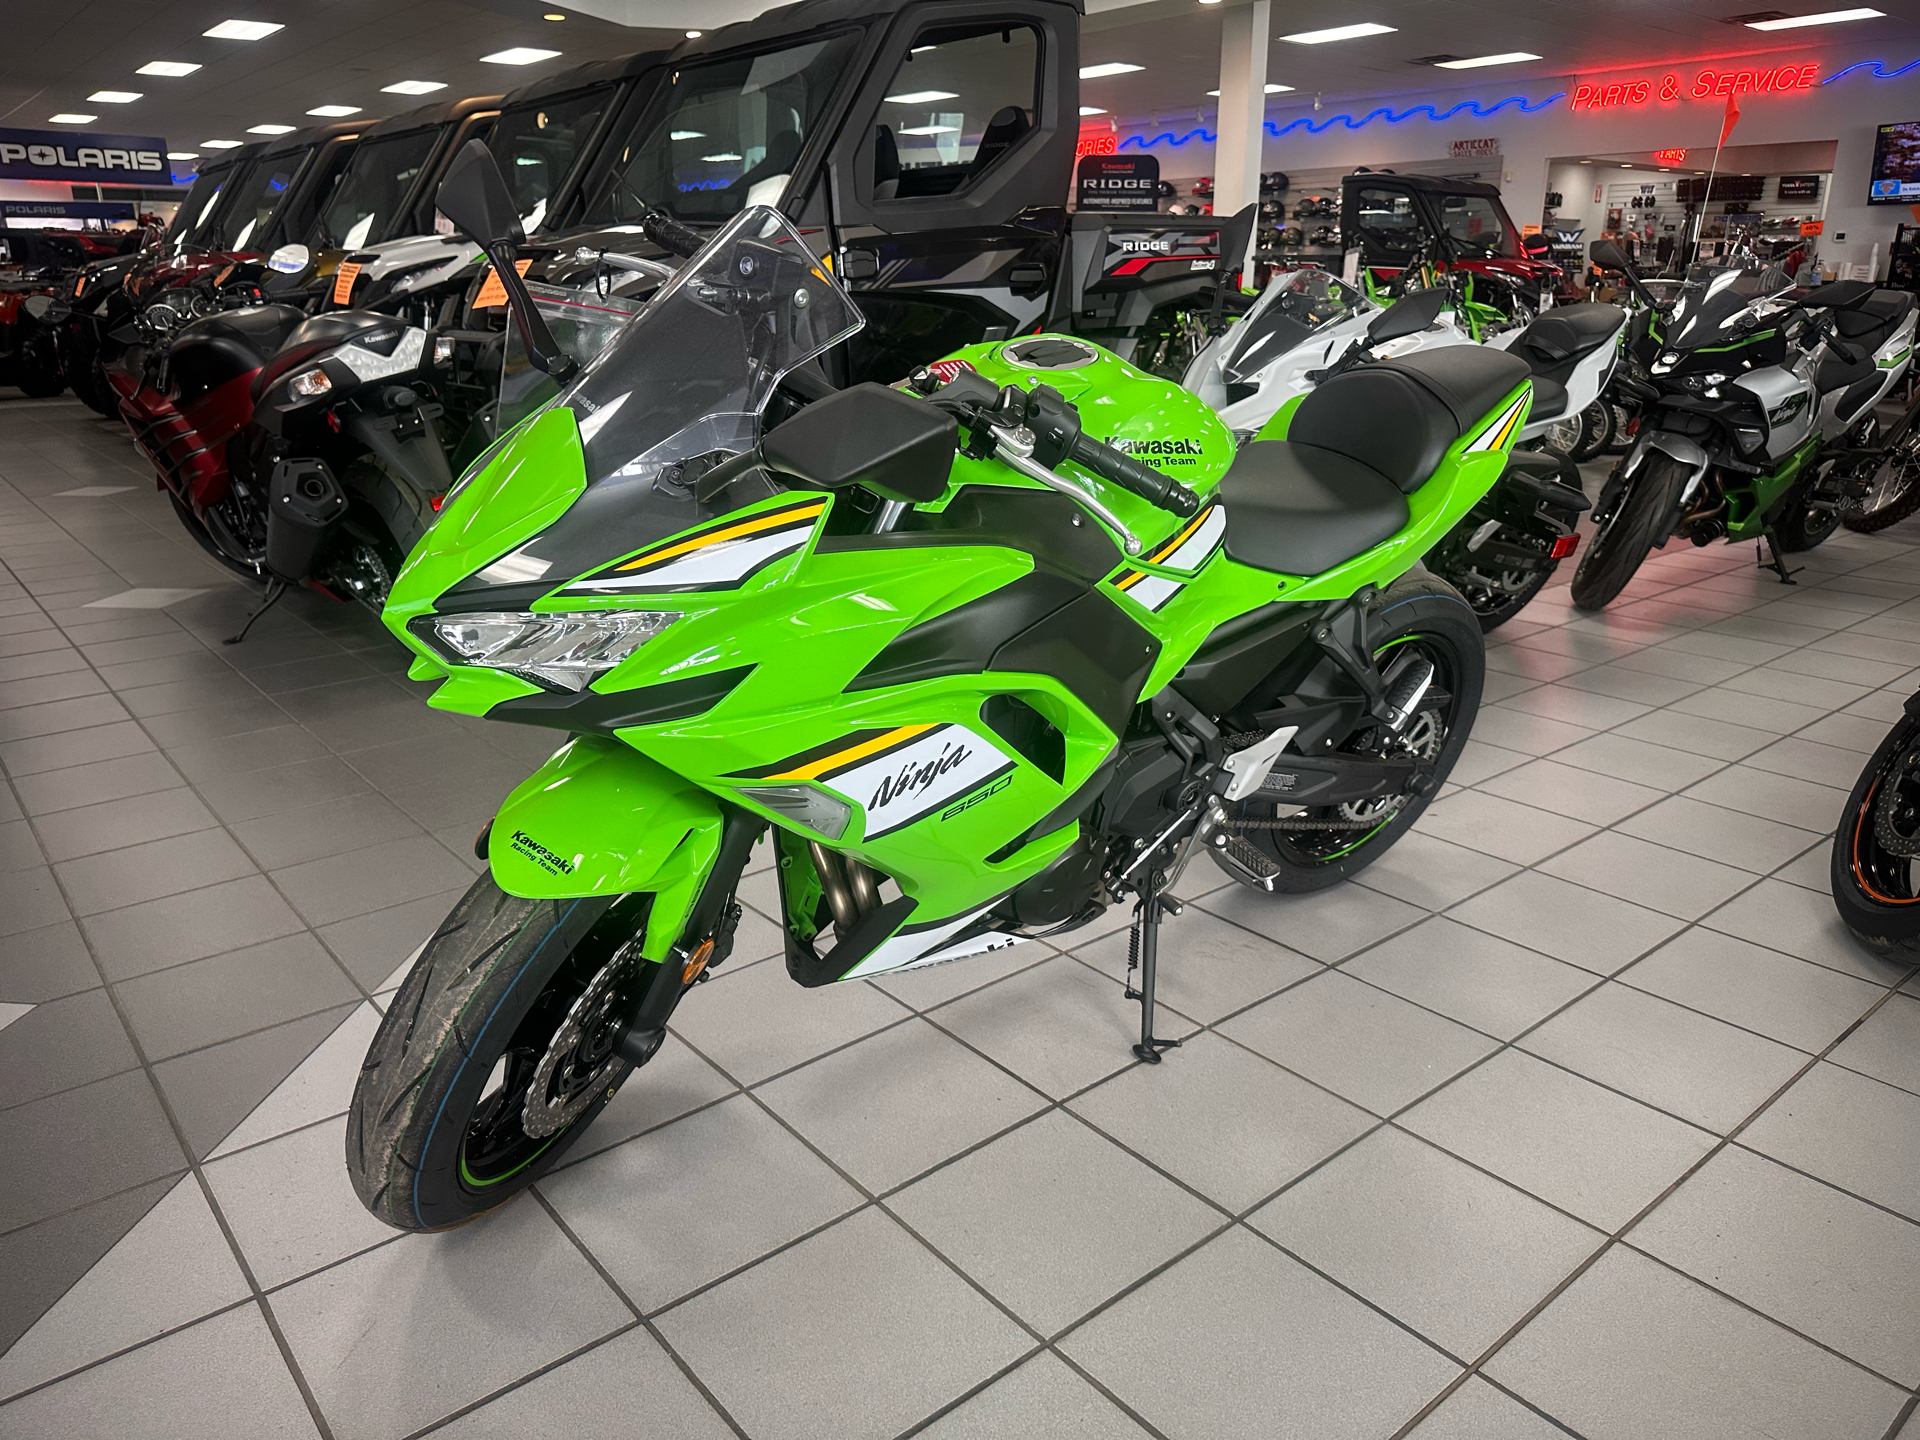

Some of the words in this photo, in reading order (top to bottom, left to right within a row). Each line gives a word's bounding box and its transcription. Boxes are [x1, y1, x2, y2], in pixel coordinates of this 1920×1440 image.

[1571, 81, 1650, 111] PARTS
[1659, 74, 1680, 101] &
[1691, 63, 1819, 98] SERVICE
[0, 142, 163, 172] POLARIS
[1083, 179, 1152, 189] RIDGE
[5, 205, 66, 214] POLARIS
[1122, 241, 1169, 252] RIDGE
[363, 329, 399, 344] Kawasaki
[1104, 436, 1203, 455] Kawasaki
[1162, 456, 1197, 466] Team
[867, 741, 973, 812] Ninja
[940, 774, 1014, 823] 650
[510, 829, 575, 875] Kawasaki
[510, 841, 537, 861] Racing
[537, 857, 558, 876] Team
